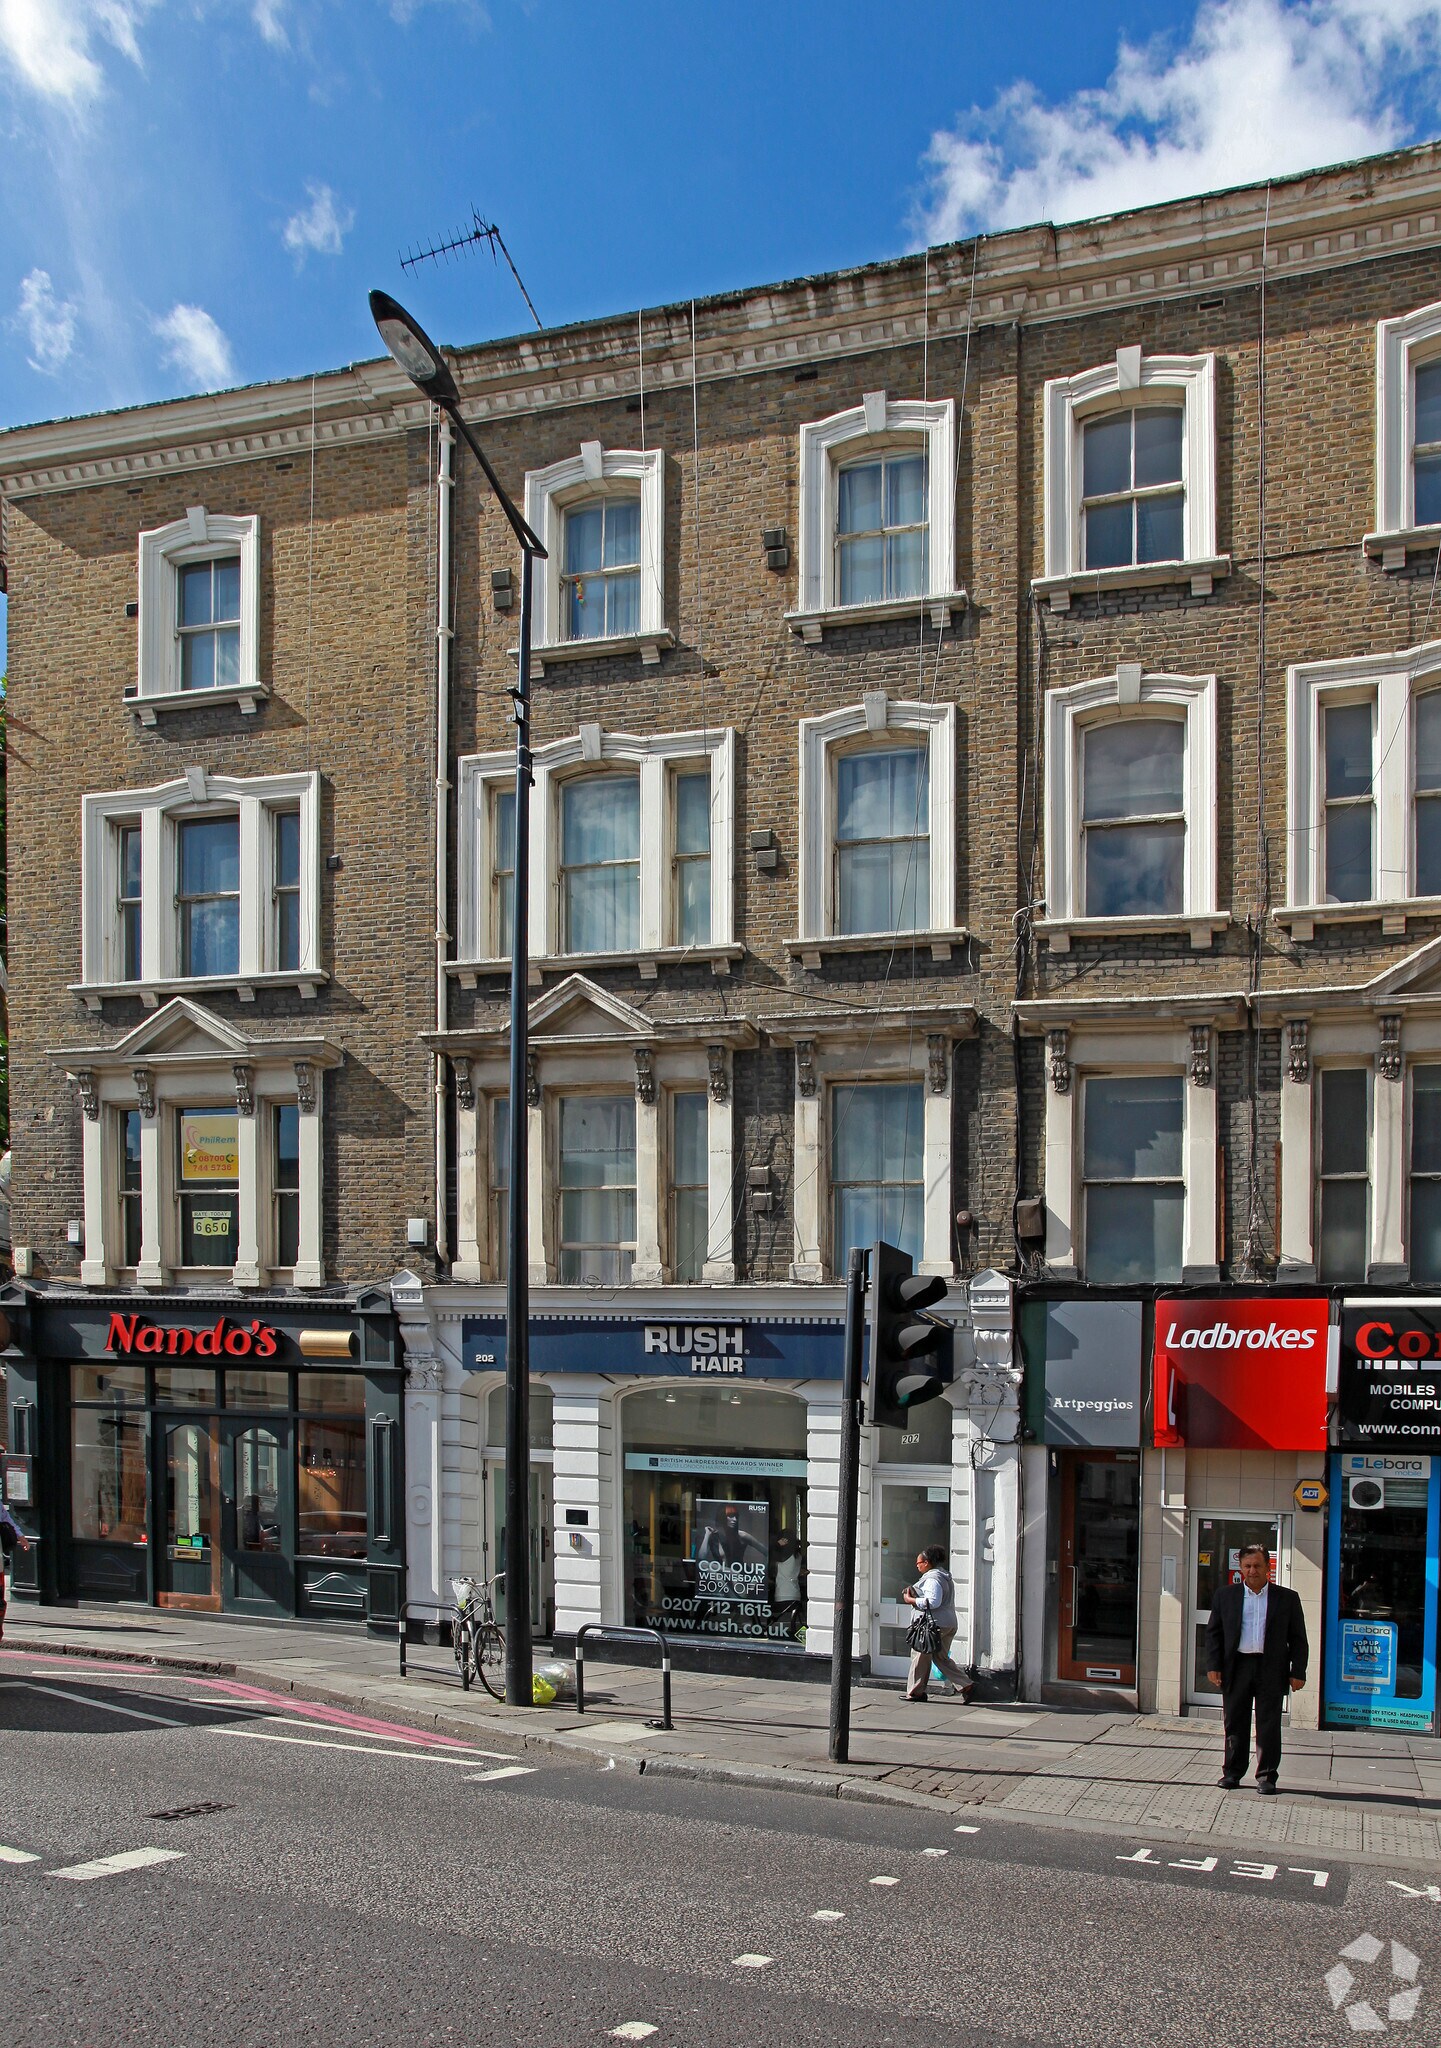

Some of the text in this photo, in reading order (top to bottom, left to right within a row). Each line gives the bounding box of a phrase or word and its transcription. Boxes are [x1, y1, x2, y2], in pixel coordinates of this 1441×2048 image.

[199, 1136, 236, 1144] PhilRem
[198, 1155, 225, 1163] 08700
[193, 1164, 208, 1172] 744
[196, 1222, 227, 1234] 6650
[104, 1312, 277, 1356] Nando's
[644, 1326, 743, 1354] RUSH
[1165, 1323, 1317, 1349] Ladbrokes
[475, 1354, 494, 1362] 202
[691, 1356, 743, 1372] HAIR
[1370, 1384, 1435, 1396] MOBILES
[1053, 1397, 1133, 1412] Artpeggios
[1358, 1424, 1441, 1435] www.conn
[902, 1434, 919, 1444] 202
[684, 1458, 729, 1466] HAIRDRESSING
[1366, 1457, 1422, 1470] Lebara
[1302, 1489, 1319, 1498] ADT
[698, 1560, 766, 1575] COLOUR
[699, 1572, 765, 1583] WEDNESDAY
[698, 1581, 765, 1595] 50% OFF
[661, 1598, 772, 1618] 0207 112 1615
[646, 1615, 789, 1638] www.rush.co.uk
[1353, 1625, 1390, 1635] Lebara
[1399, 1712, 1429, 1720] HEADPHONES
[1115, 1848, 1329, 1887] LEFT
